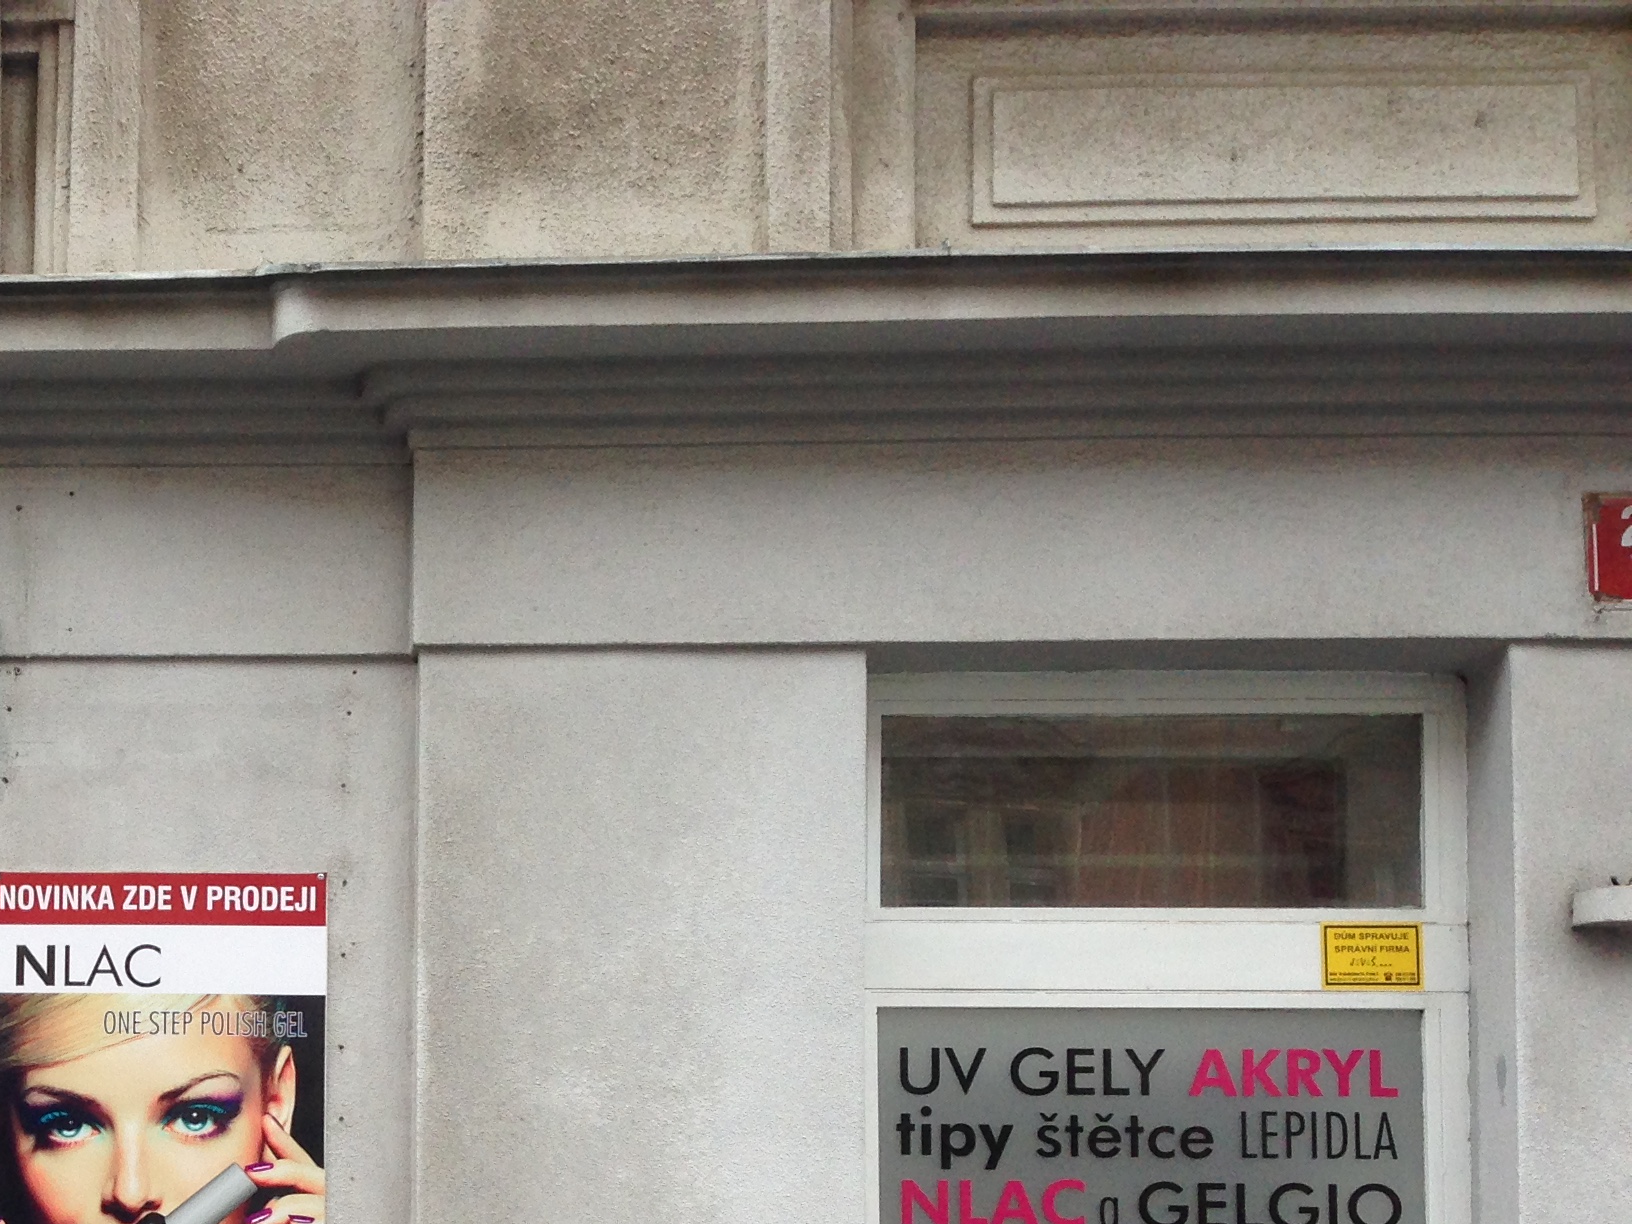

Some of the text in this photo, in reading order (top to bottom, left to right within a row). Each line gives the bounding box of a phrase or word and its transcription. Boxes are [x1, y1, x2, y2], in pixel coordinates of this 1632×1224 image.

[122, 884, 172, 911] ZDE
[180, 885, 198, 911] V
[206, 885, 317, 912] PRODEJI
[15, 944, 162, 988] NLAC
[1380, 945, 1410, 953] FIRMA
[104, 1011, 307, 1038] ONE STEP POLISH GEL
[900, 1048, 1398, 1097] UV GELY AKRYL
[896, 1106, 1397, 1170] tipy štětce LEPIDLA
